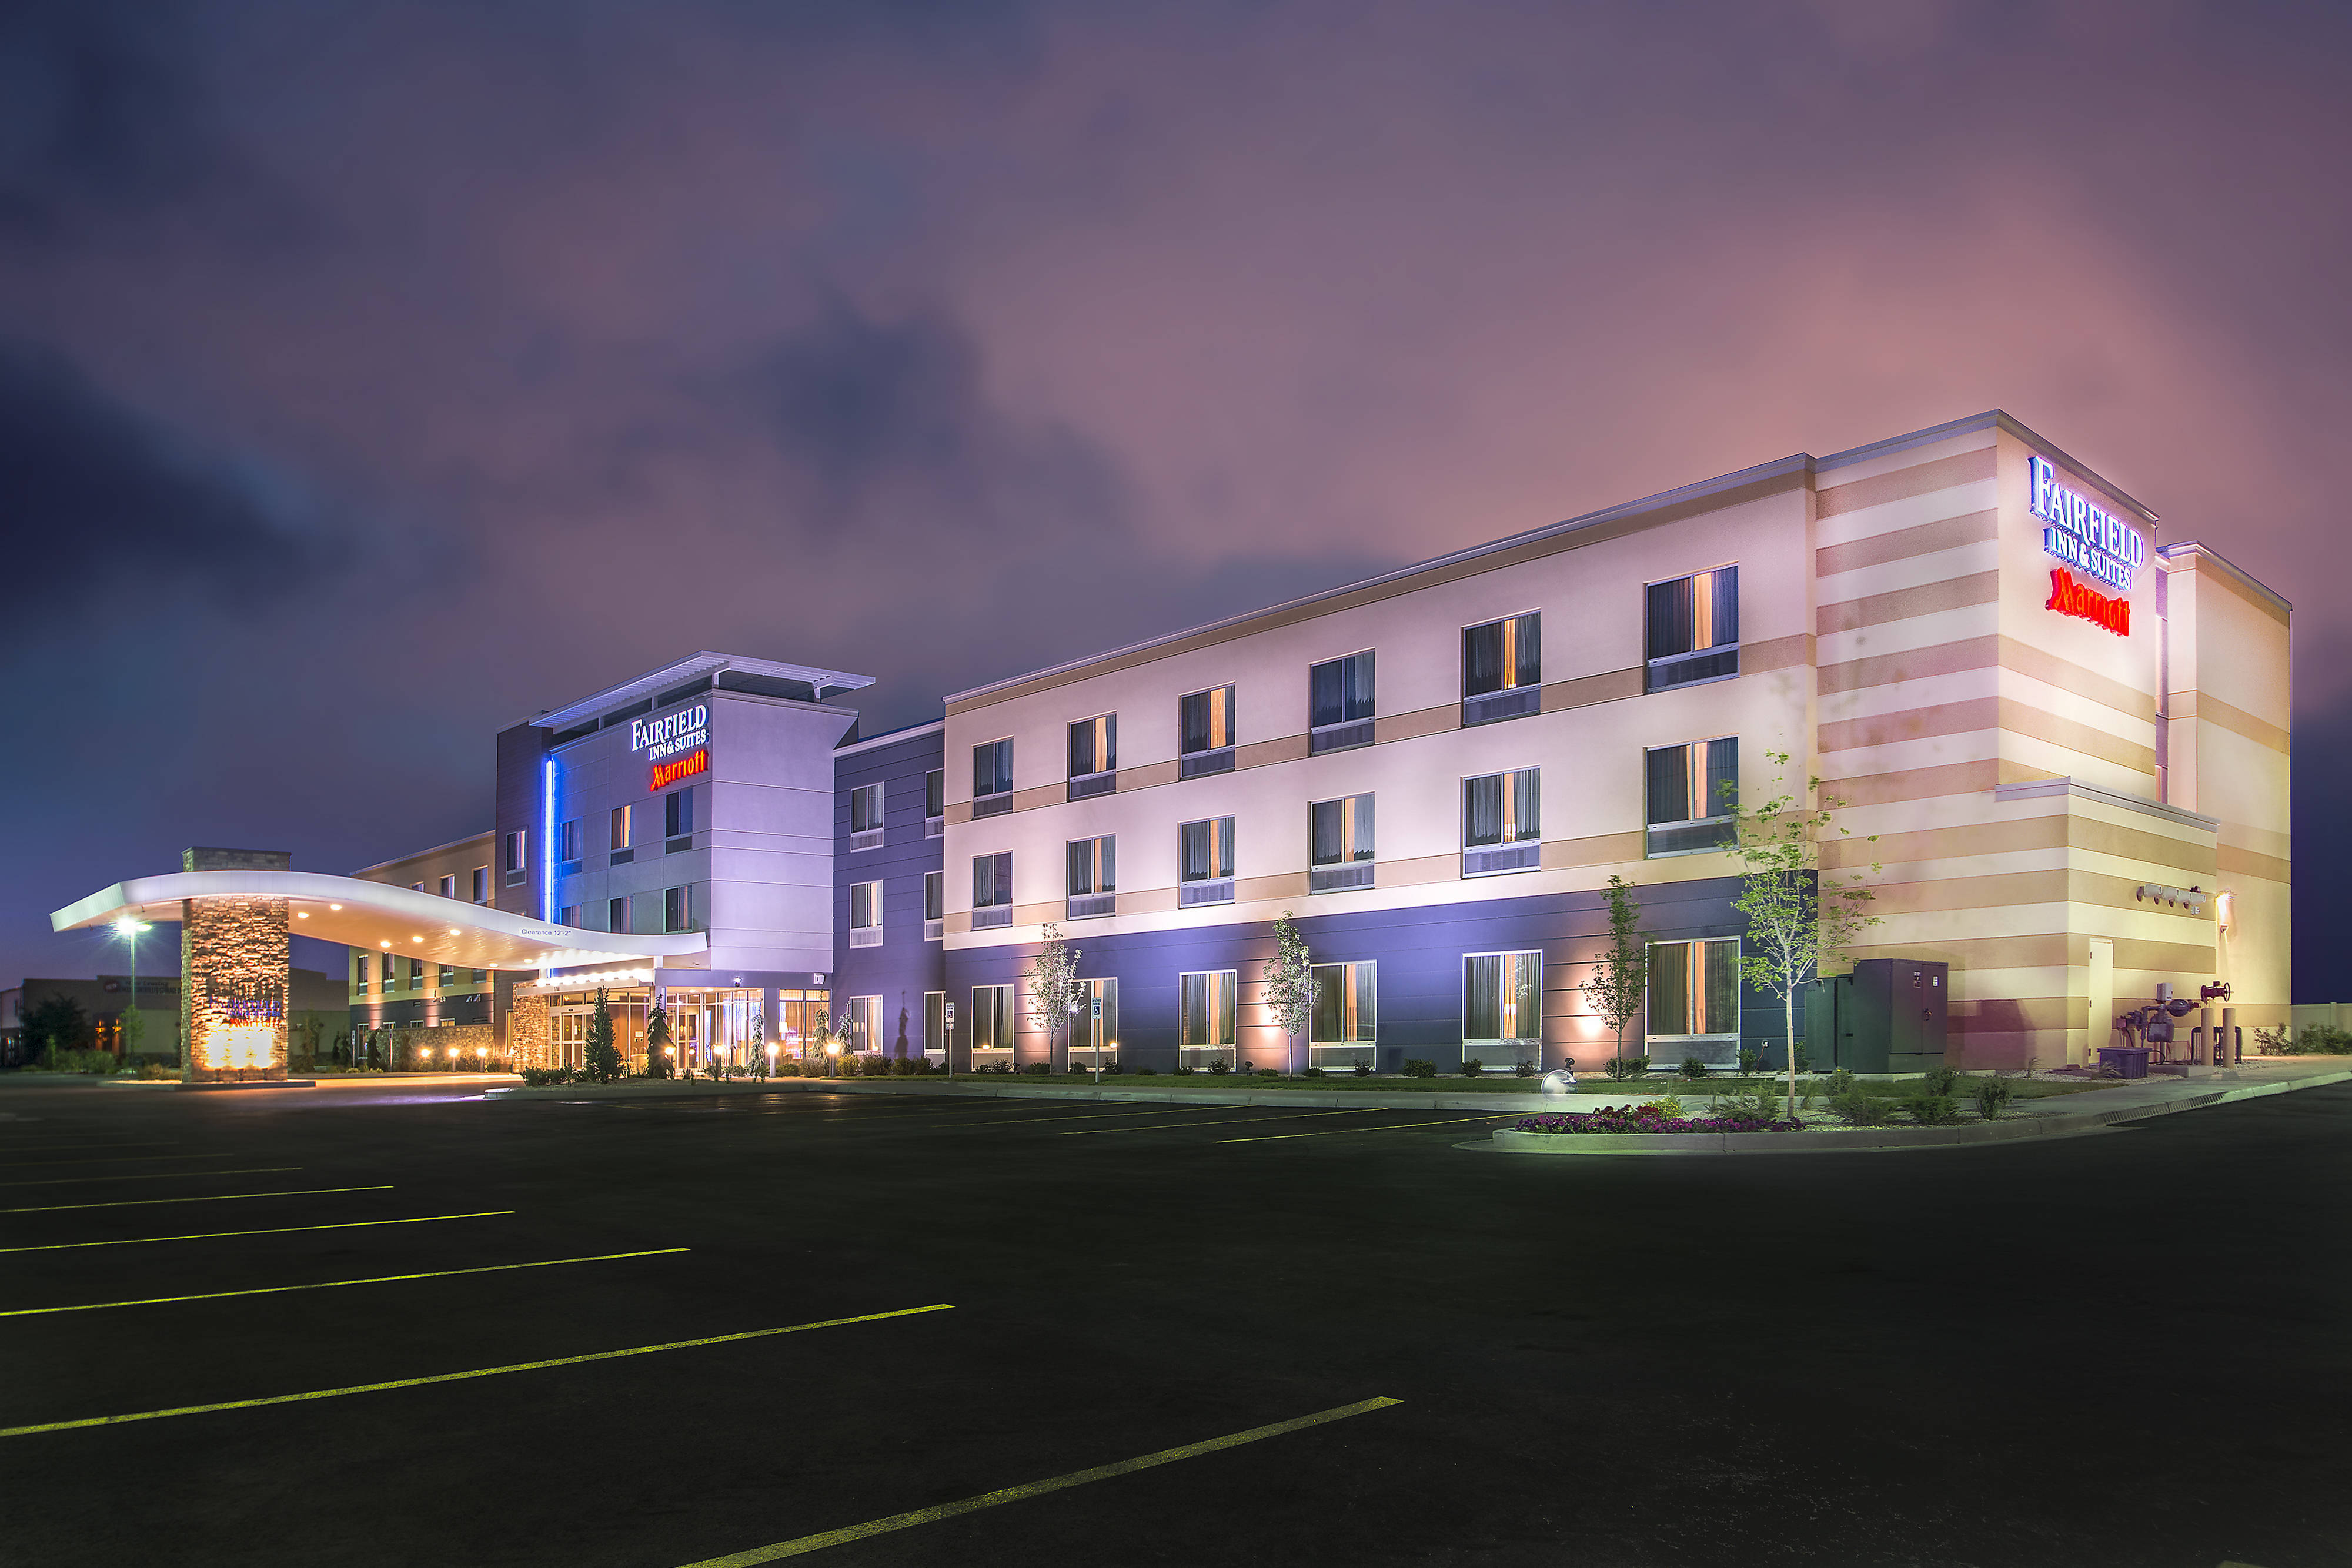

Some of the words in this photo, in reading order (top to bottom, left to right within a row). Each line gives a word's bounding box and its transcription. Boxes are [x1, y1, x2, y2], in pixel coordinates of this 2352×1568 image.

[2028, 455, 2144, 569] FAIRFIELD
[2043, 526, 2079, 563] INN
[2078, 543, 2090, 569] &
[2090, 550, 2133, 590] SUITES
[2045, 567, 2131, 636] Marriott
[631, 704, 709, 751] FAIRFIELD
[649, 743, 667, 761] INN
[667, 740, 675, 755] &
[674, 728, 707, 753] SUITES
[650, 749, 707, 792] Marriott
